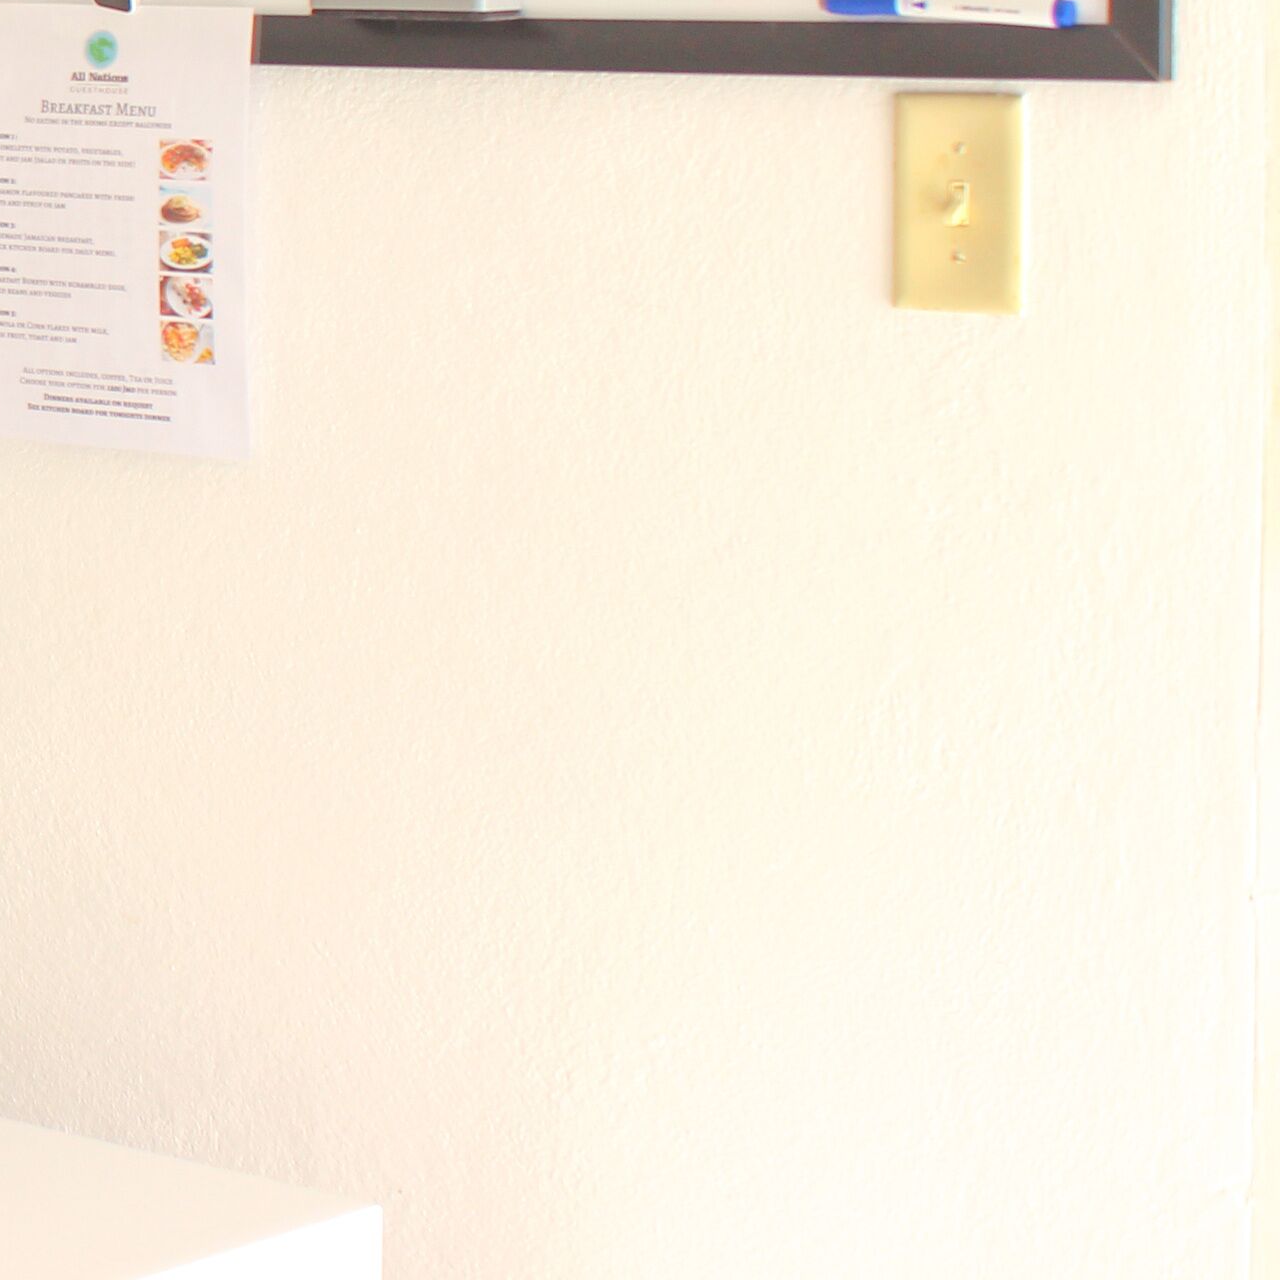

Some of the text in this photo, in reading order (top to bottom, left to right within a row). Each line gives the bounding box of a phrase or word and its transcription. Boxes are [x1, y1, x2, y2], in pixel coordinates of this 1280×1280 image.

[71, 72, 129, 82] All Nations
[69, 86, 129, 95] GUESTHOUSE
[40, 100, 157, 117] BREAKFAST MENU
